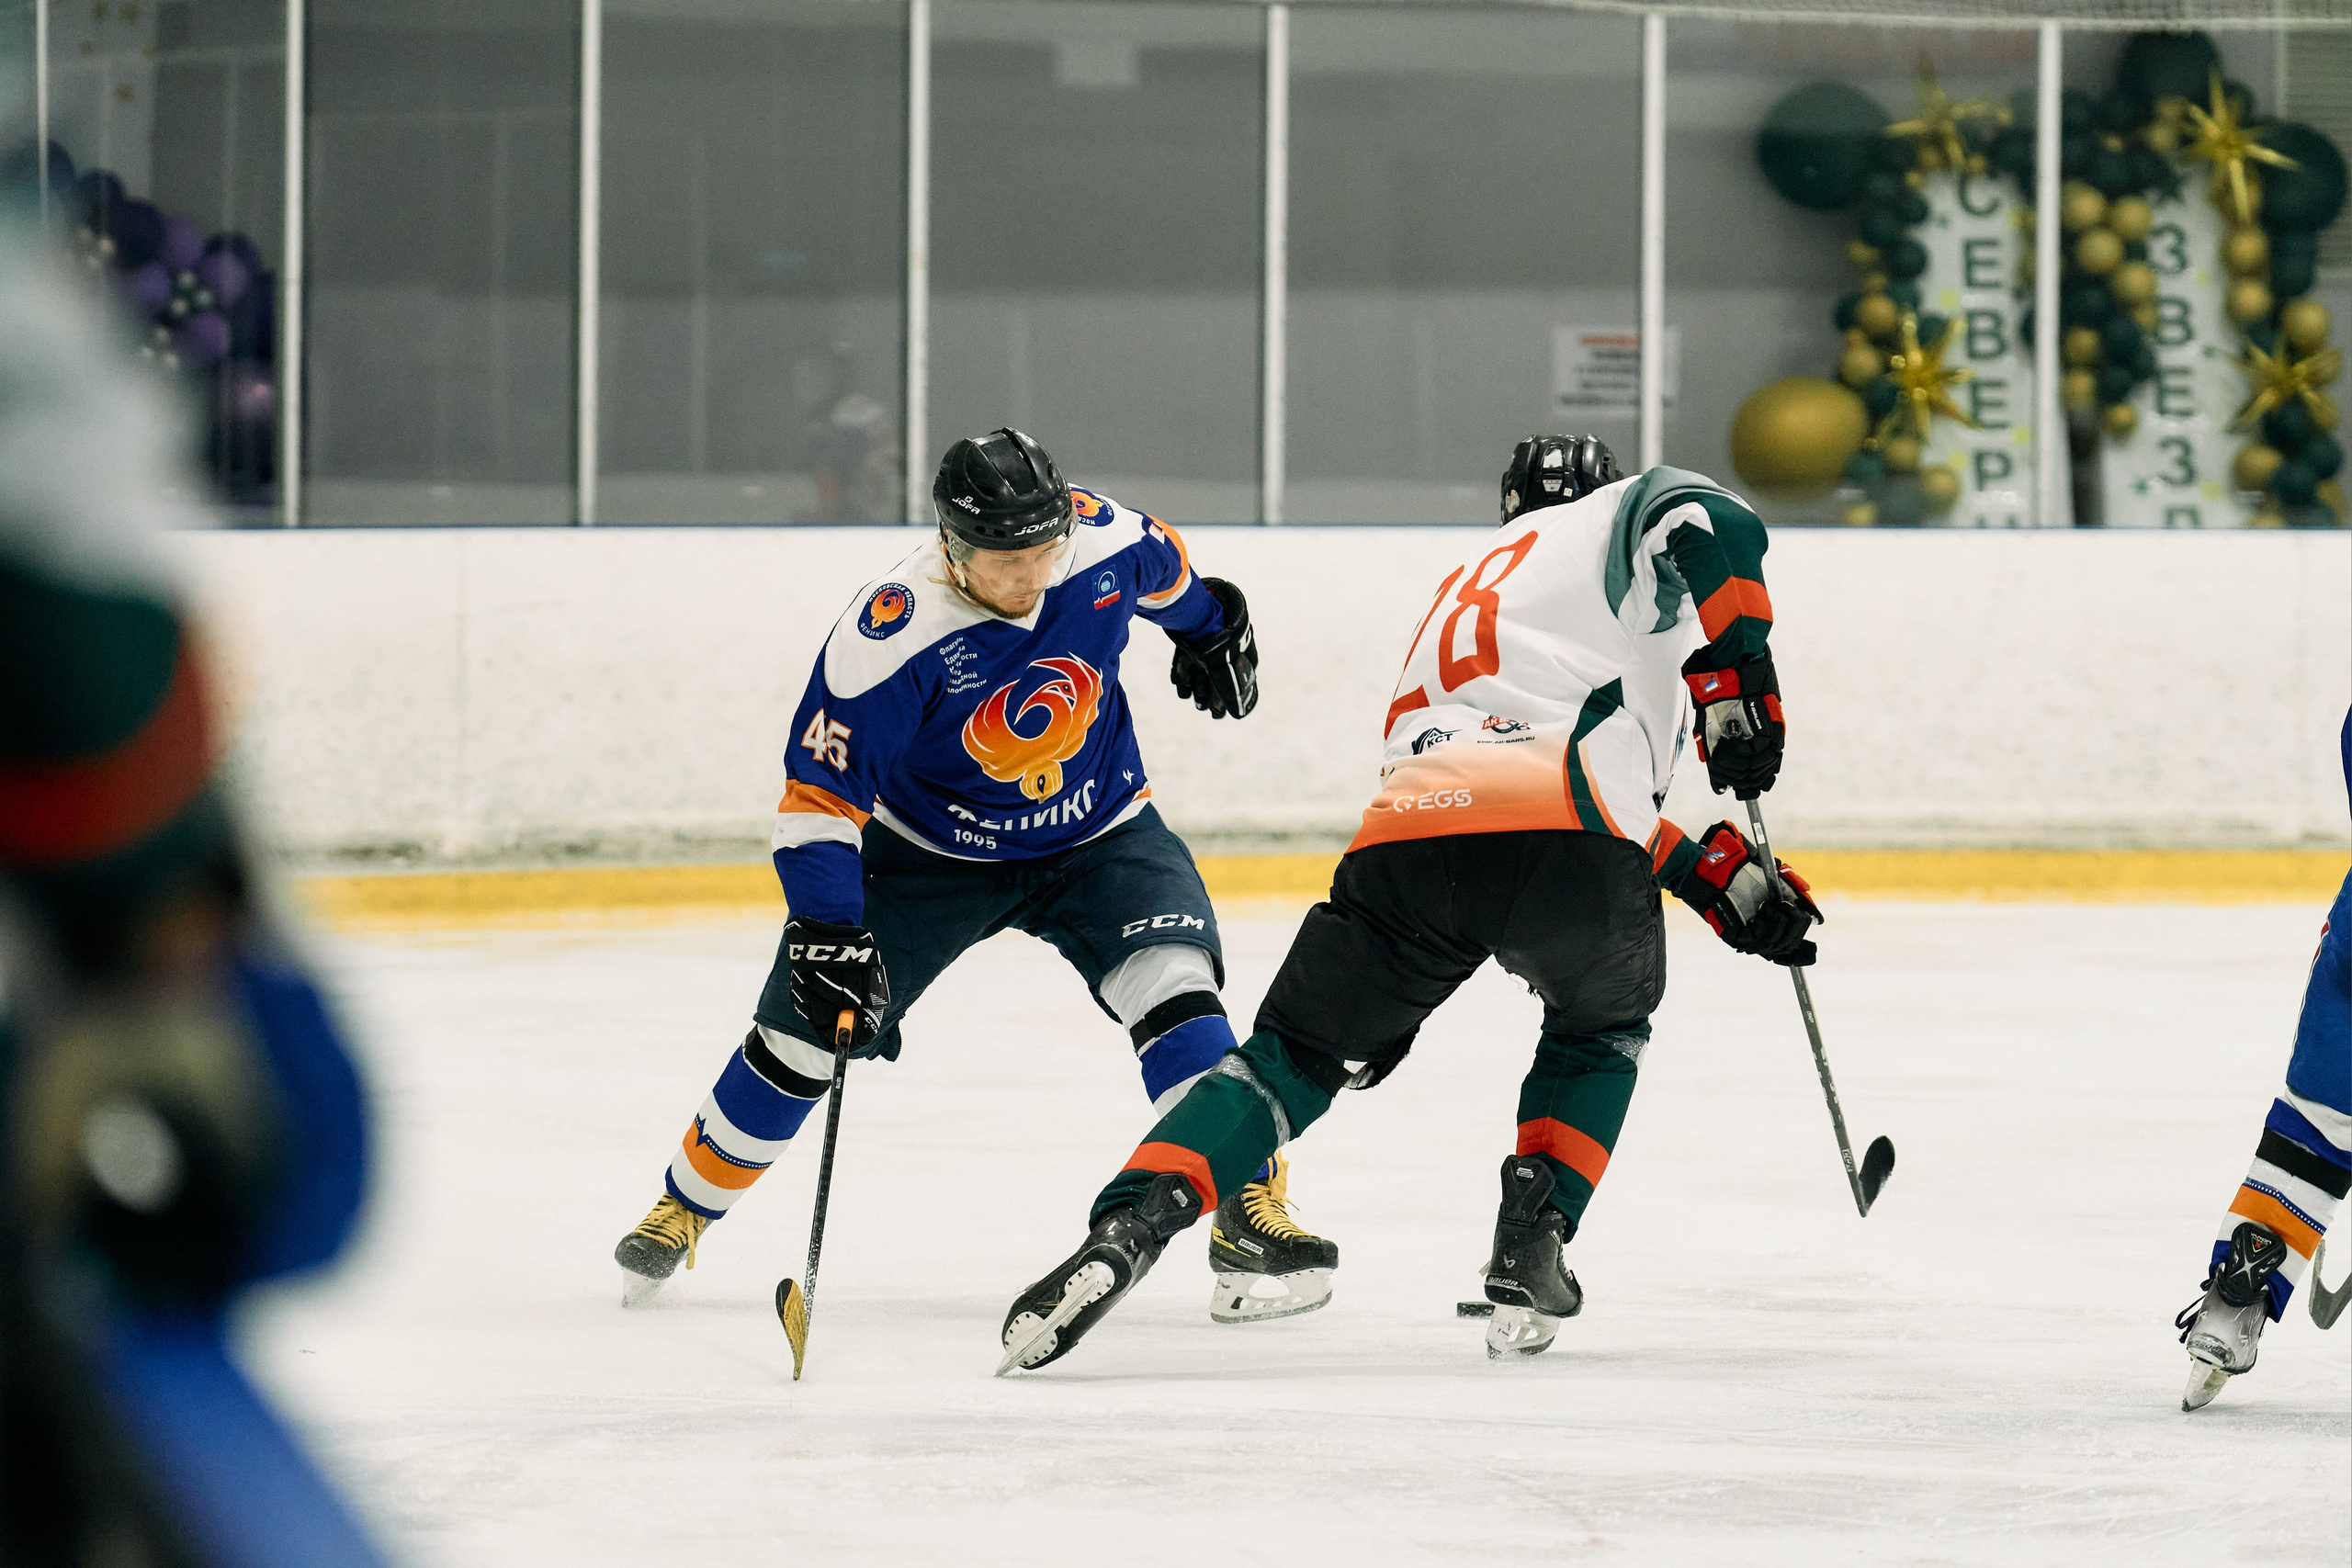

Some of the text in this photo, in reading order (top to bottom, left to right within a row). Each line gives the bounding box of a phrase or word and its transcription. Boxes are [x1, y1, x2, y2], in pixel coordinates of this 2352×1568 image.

[952, 497, 981, 514] JOFA
[1014, 517, 1058, 536] JOFA
[860, 623, 885, 637] ФЕНИКС
[1384, 530, 1539, 740] 28
[801, 707, 852, 772] 45
[954, 829, 998, 850] 1995
[1122, 914, 1205, 938] CCM
[788, 943, 873, 963] CCM
[1240, 1240, 1261, 1253] BAUER
